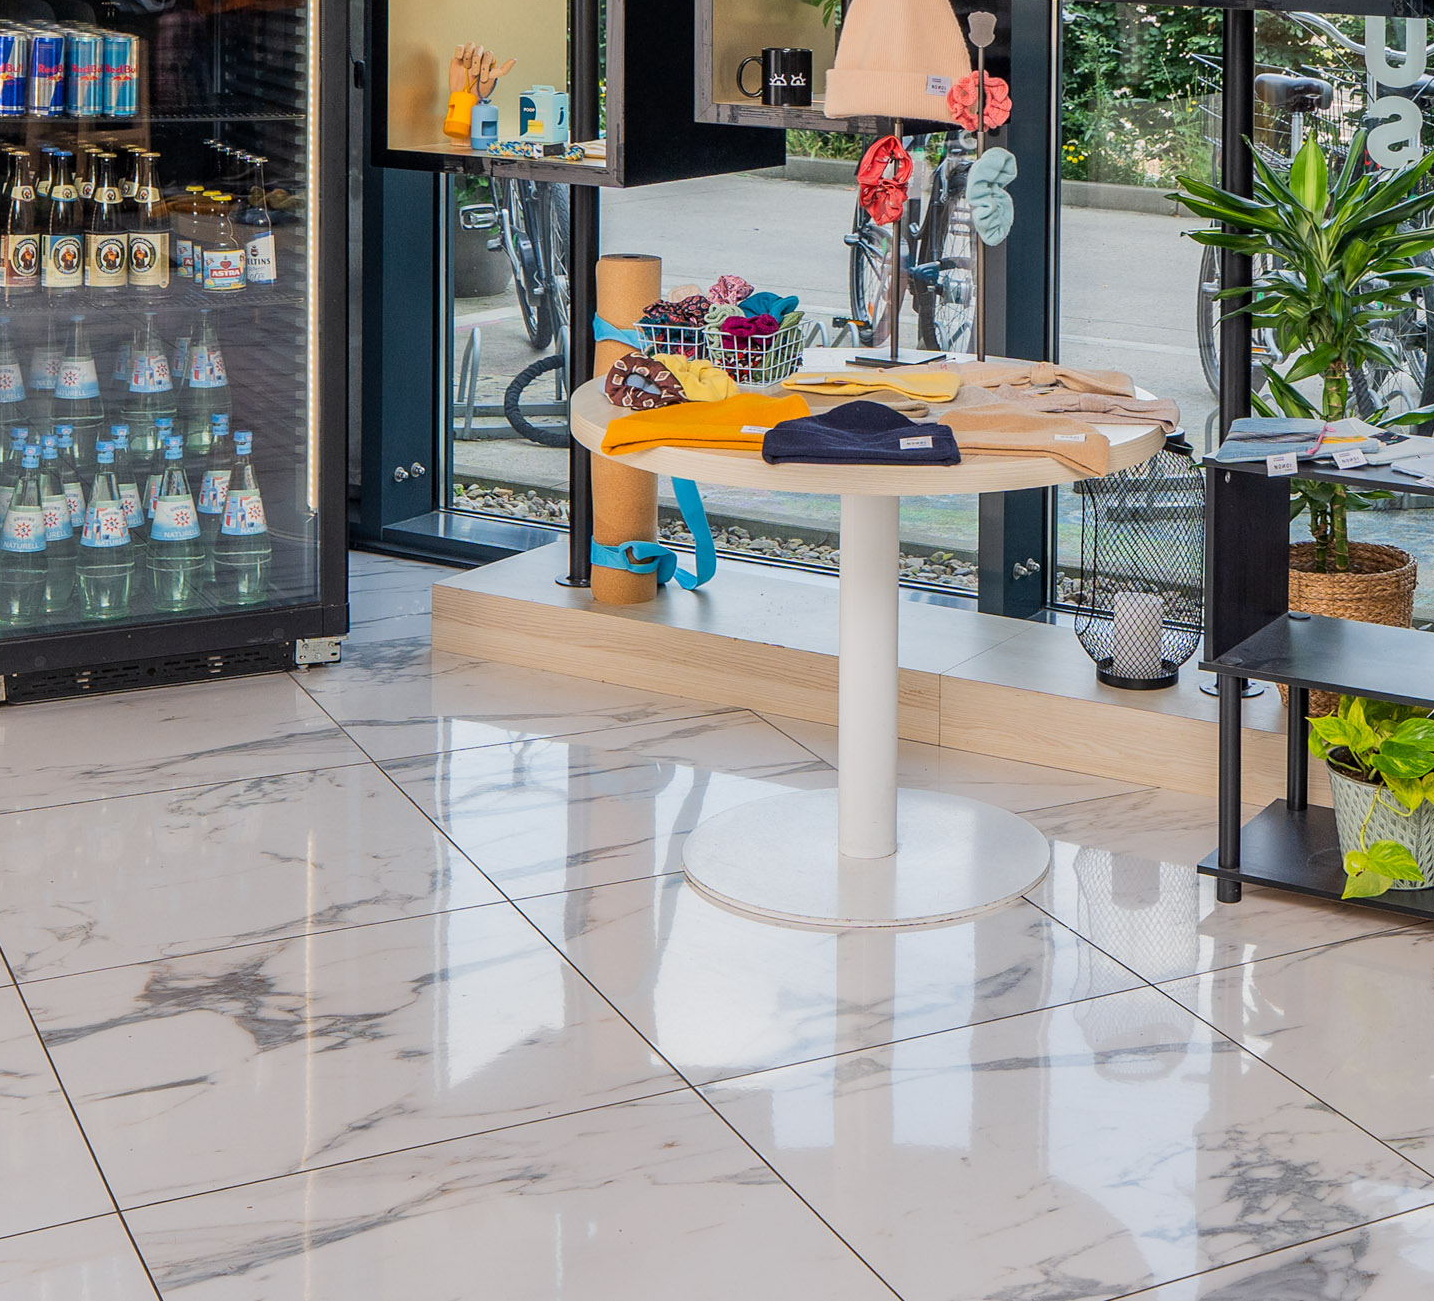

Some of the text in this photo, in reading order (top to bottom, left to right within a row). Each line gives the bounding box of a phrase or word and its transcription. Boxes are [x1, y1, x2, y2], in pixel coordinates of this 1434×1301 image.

[38, 63, 57, 73] Red
[72, 63, 90, 73] Red
[105, 63, 122, 73] Red
[247, 256, 272, 268] ELTINS
[210, 269, 241, 278] ASTRA
[164, 530, 200, 539] NATURELL
[4, 541, 40, 550] NATURELL
